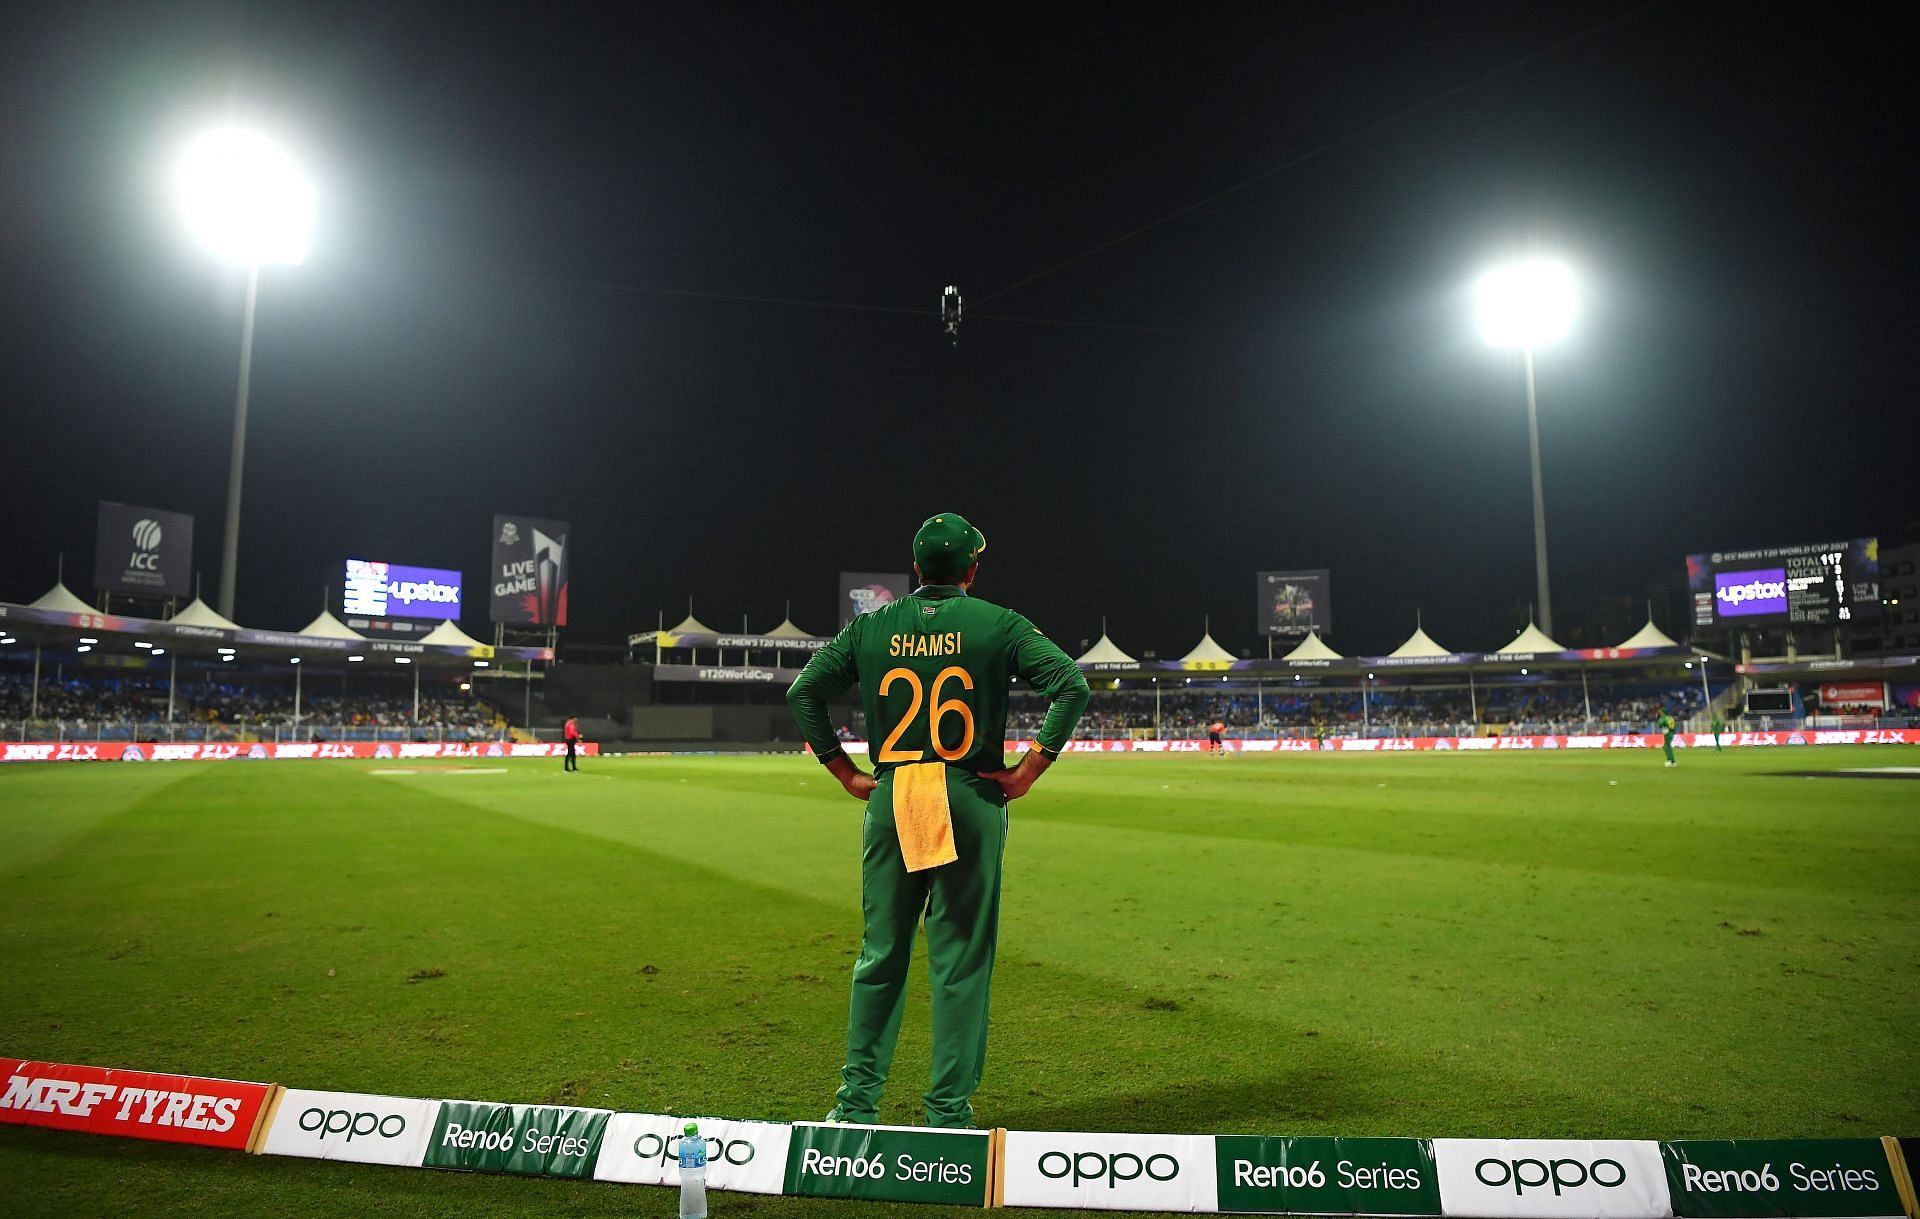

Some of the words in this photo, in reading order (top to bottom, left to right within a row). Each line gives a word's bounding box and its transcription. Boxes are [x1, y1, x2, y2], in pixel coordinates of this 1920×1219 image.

[130, 552, 159, 570] ICC
[503, 560, 535, 577] LIVE
[390, 580, 459, 605] upstox
[495, 578, 537, 597] GAME
[1718, 580, 1785, 606] upstox
[717, 638, 731, 646] ICC
[760, 638, 775, 647] T20
[775, 639, 807, 648] WORLD
[889, 632, 961, 657] SHAMSI
[700, 669, 774, 681] #T20WorldCup
[878, 666, 975, 762] 26
[0, 1075, 118, 1117] MRF
[115, 1087, 242, 1133] TYRES
[298, 1107, 406, 1143] oppo
[442, 1122, 514, 1152] Reno6
[522, 1128, 589, 1157] Series
[800, 1148, 885, 1180] Reno6
[895, 1153, 972, 1185] Series
[1038, 1151, 1180, 1188] oppo
[1234, 1159, 1326, 1188] Reno6
[1337, 1160, 1421, 1190] Series
[1474, 1157, 1626, 1196] oppo
[1682, 1163, 1780, 1192] Reno6
[1789, 1162, 1880, 1192] Series
